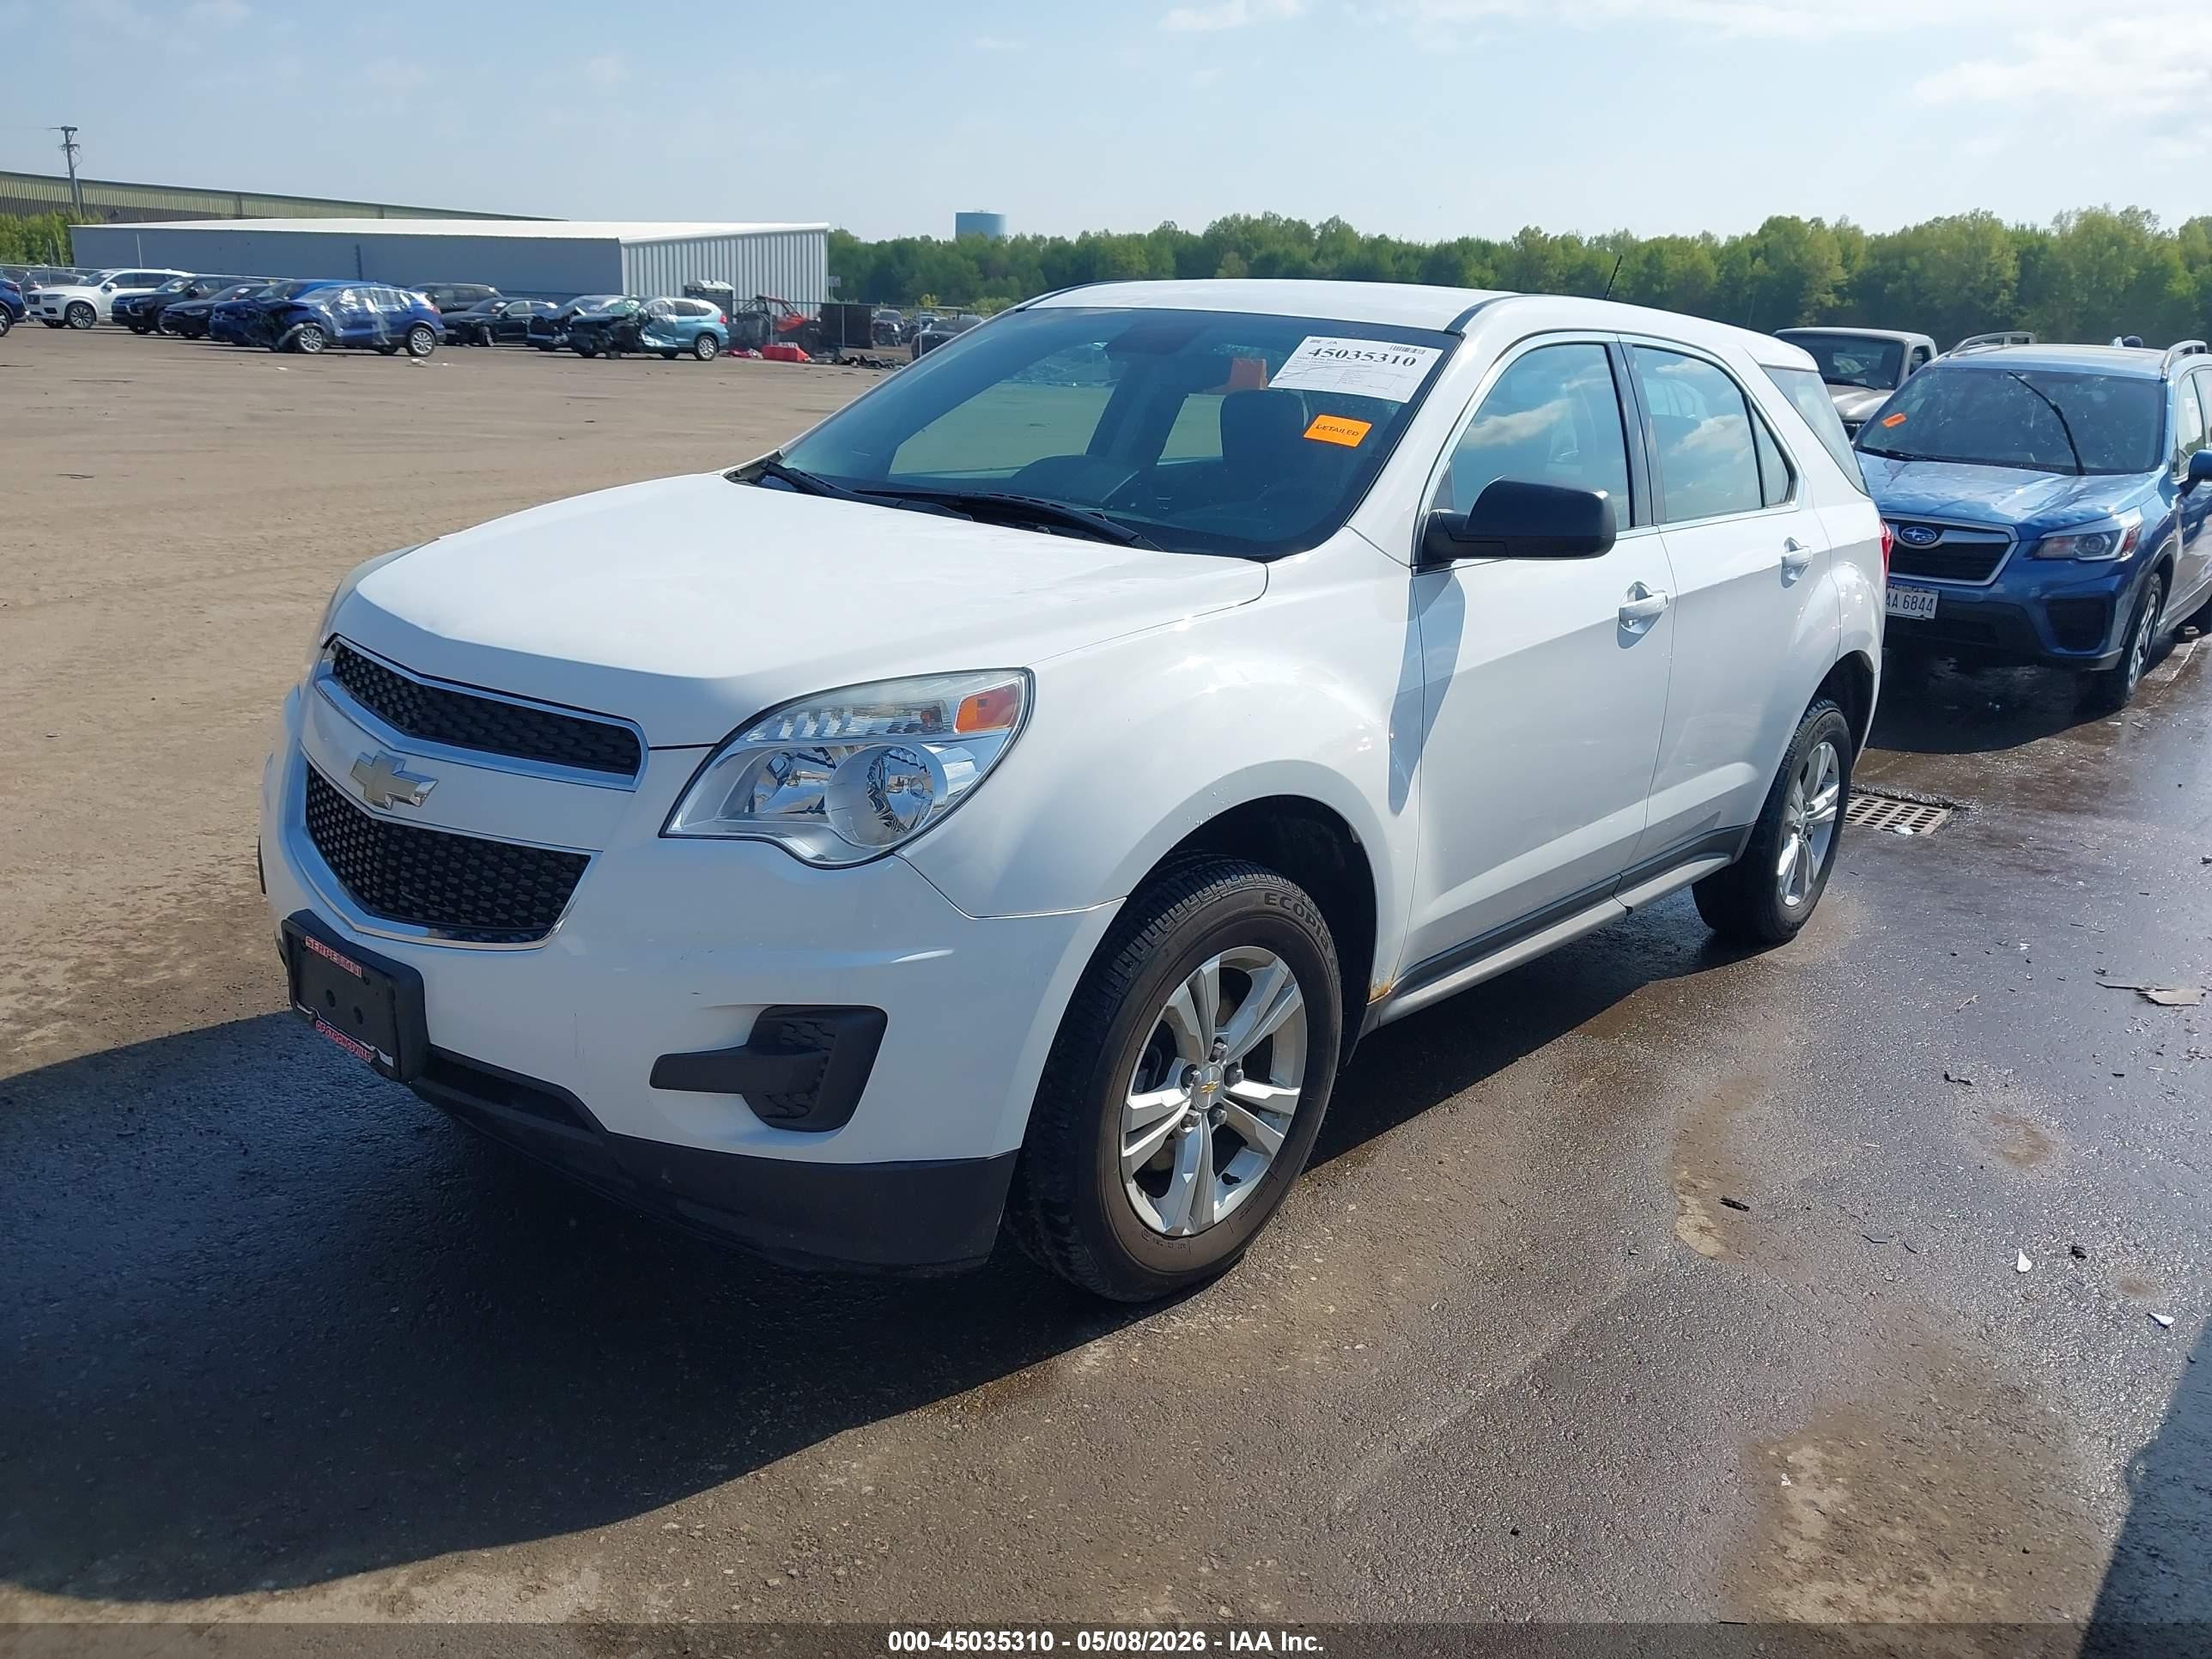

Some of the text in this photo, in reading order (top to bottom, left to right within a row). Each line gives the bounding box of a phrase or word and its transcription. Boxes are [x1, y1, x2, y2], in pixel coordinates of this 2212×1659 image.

[1307, 347, 1417, 368] 45035310
[1316, 424, 1359, 436] DETAILED
[1902, 594, 1934, 612] 6844
